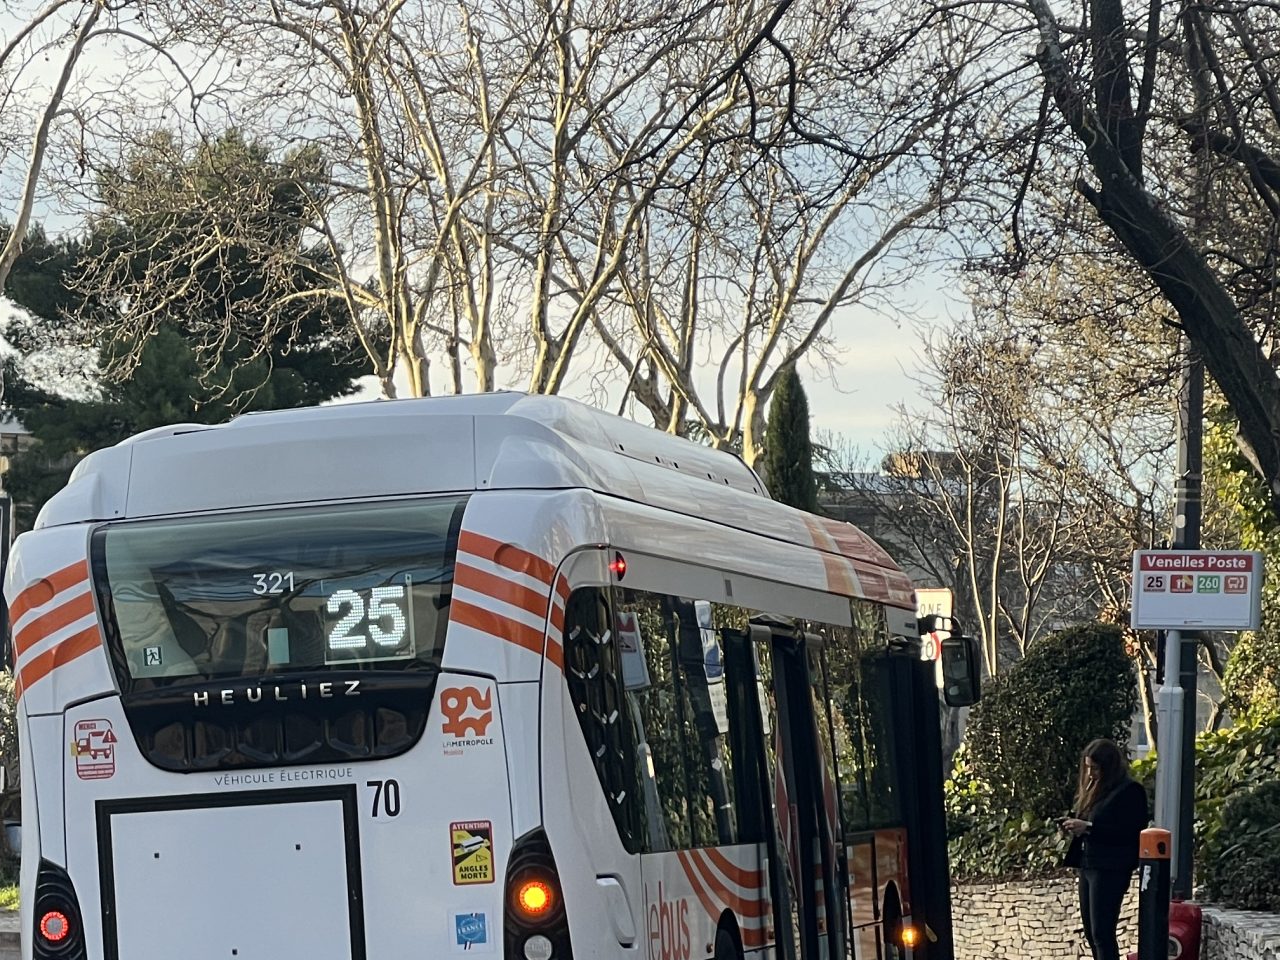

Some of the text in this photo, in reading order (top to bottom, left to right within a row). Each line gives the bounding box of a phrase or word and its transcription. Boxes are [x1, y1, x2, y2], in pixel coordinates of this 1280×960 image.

[1147, 556, 1246, 568] Venelles Poste
[253, 572, 295, 594] 321
[1148, 576, 1163, 588] 25
[1199, 577, 1219, 588] 260
[327, 586, 406, 649] 25
[214, 768, 353, 787] VÉHICULE ÉLECTRIQUE
[366, 779, 401, 818] 70
[452, 821, 490, 831] ATTENTION
[459, 865, 488, 873] ANGLES
[460, 872, 487, 880] MORTS
